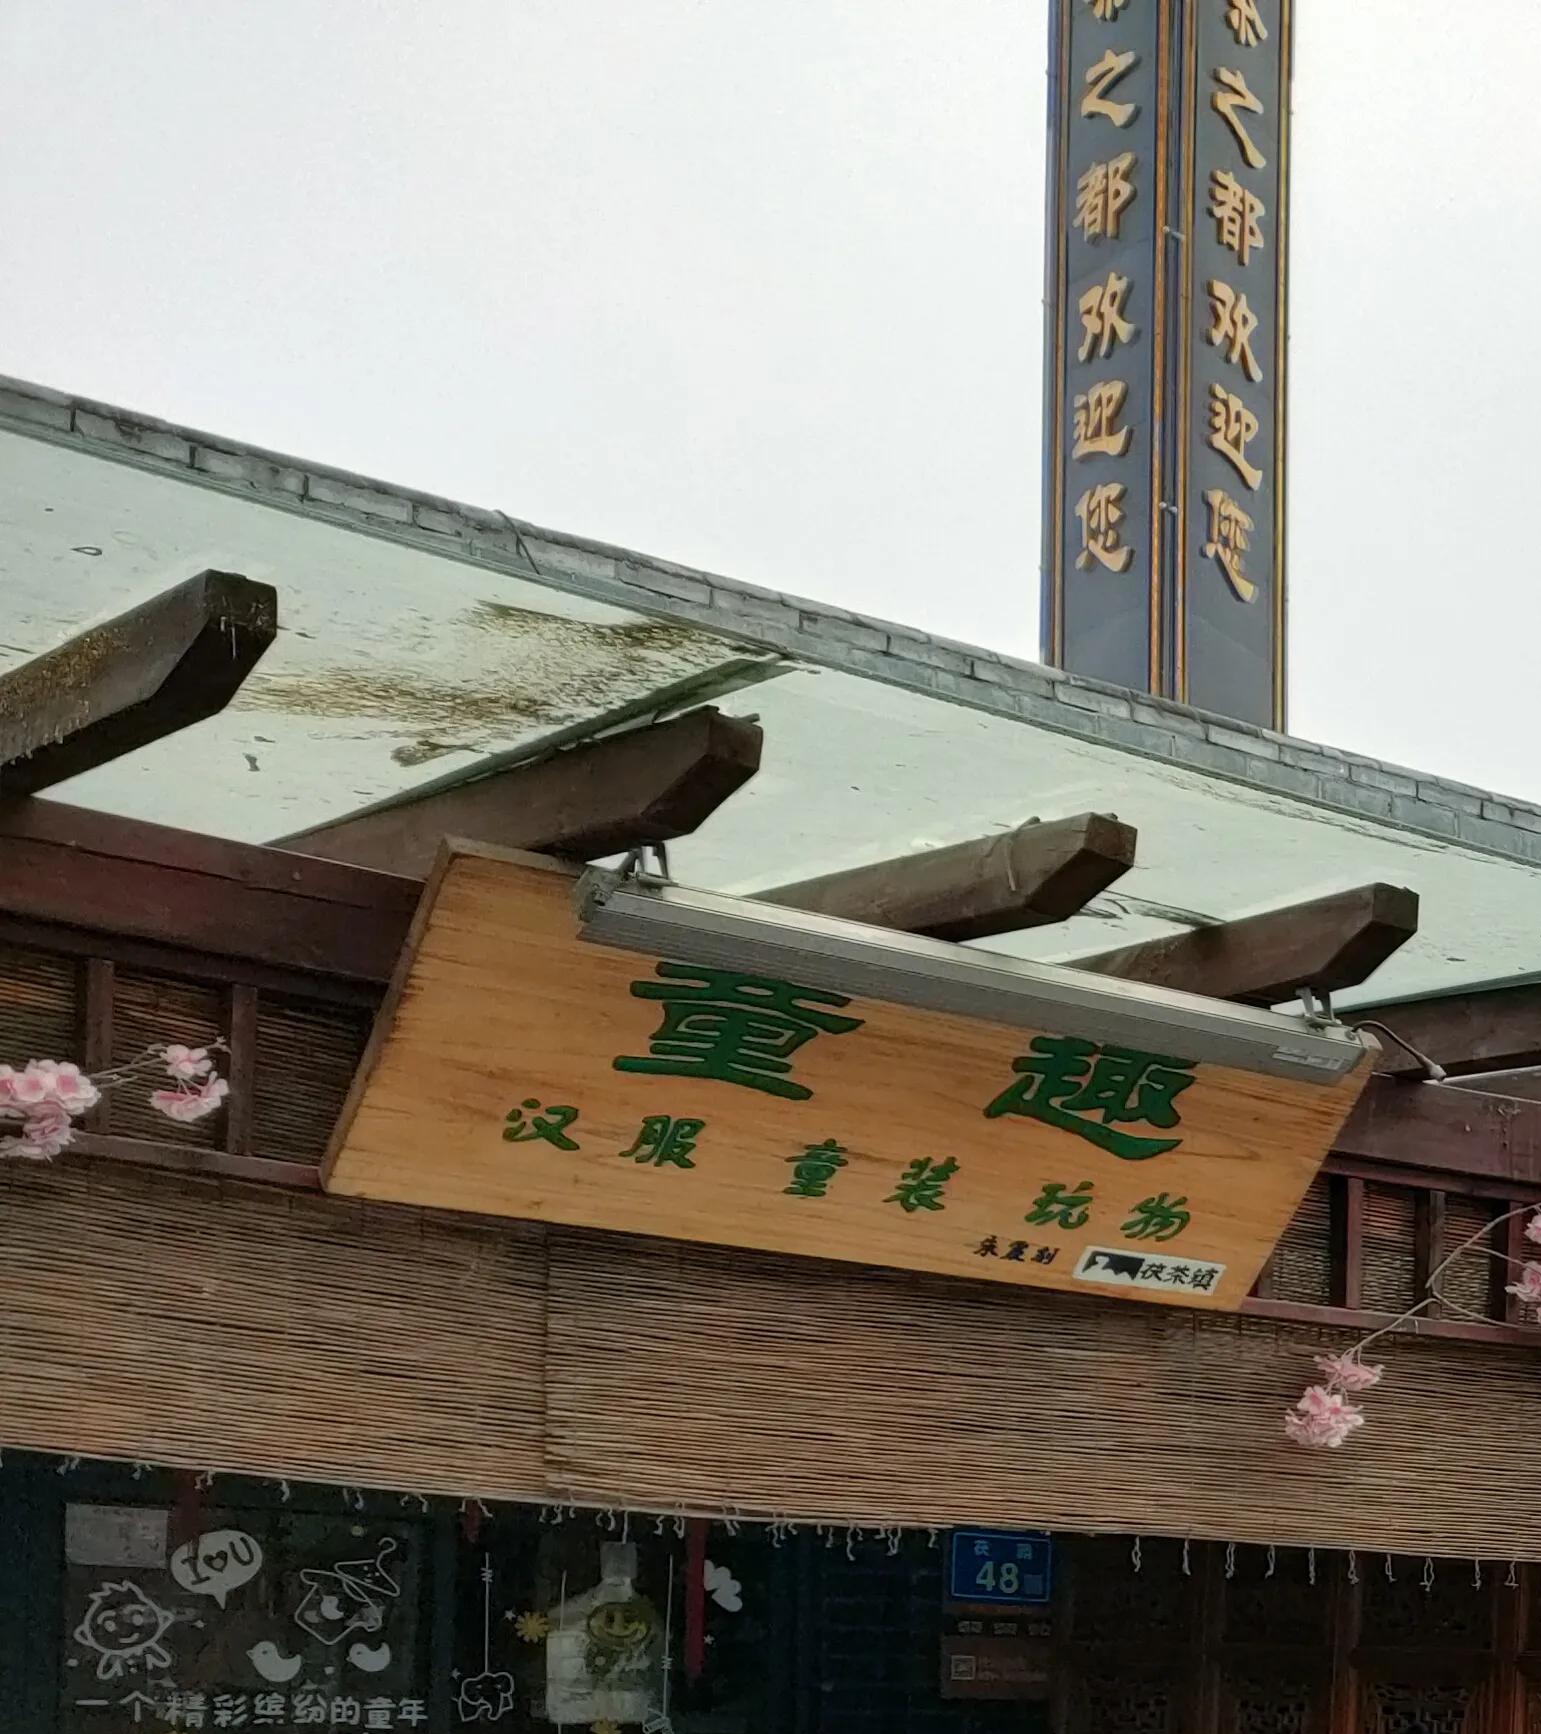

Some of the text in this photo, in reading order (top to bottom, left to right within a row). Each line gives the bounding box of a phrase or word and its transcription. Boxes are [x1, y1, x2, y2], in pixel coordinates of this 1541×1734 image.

[612, 962, 1199, 1160] 童趣
[502, 1098, 1190, 1242] 汉服 童装 玩物
[1140, 1262, 1220, 1290] 茯茶镇
[976, 1560, 1020, 1594] 48
[74, 1690, 430, 1730] 一个精彩缤纷的童年
